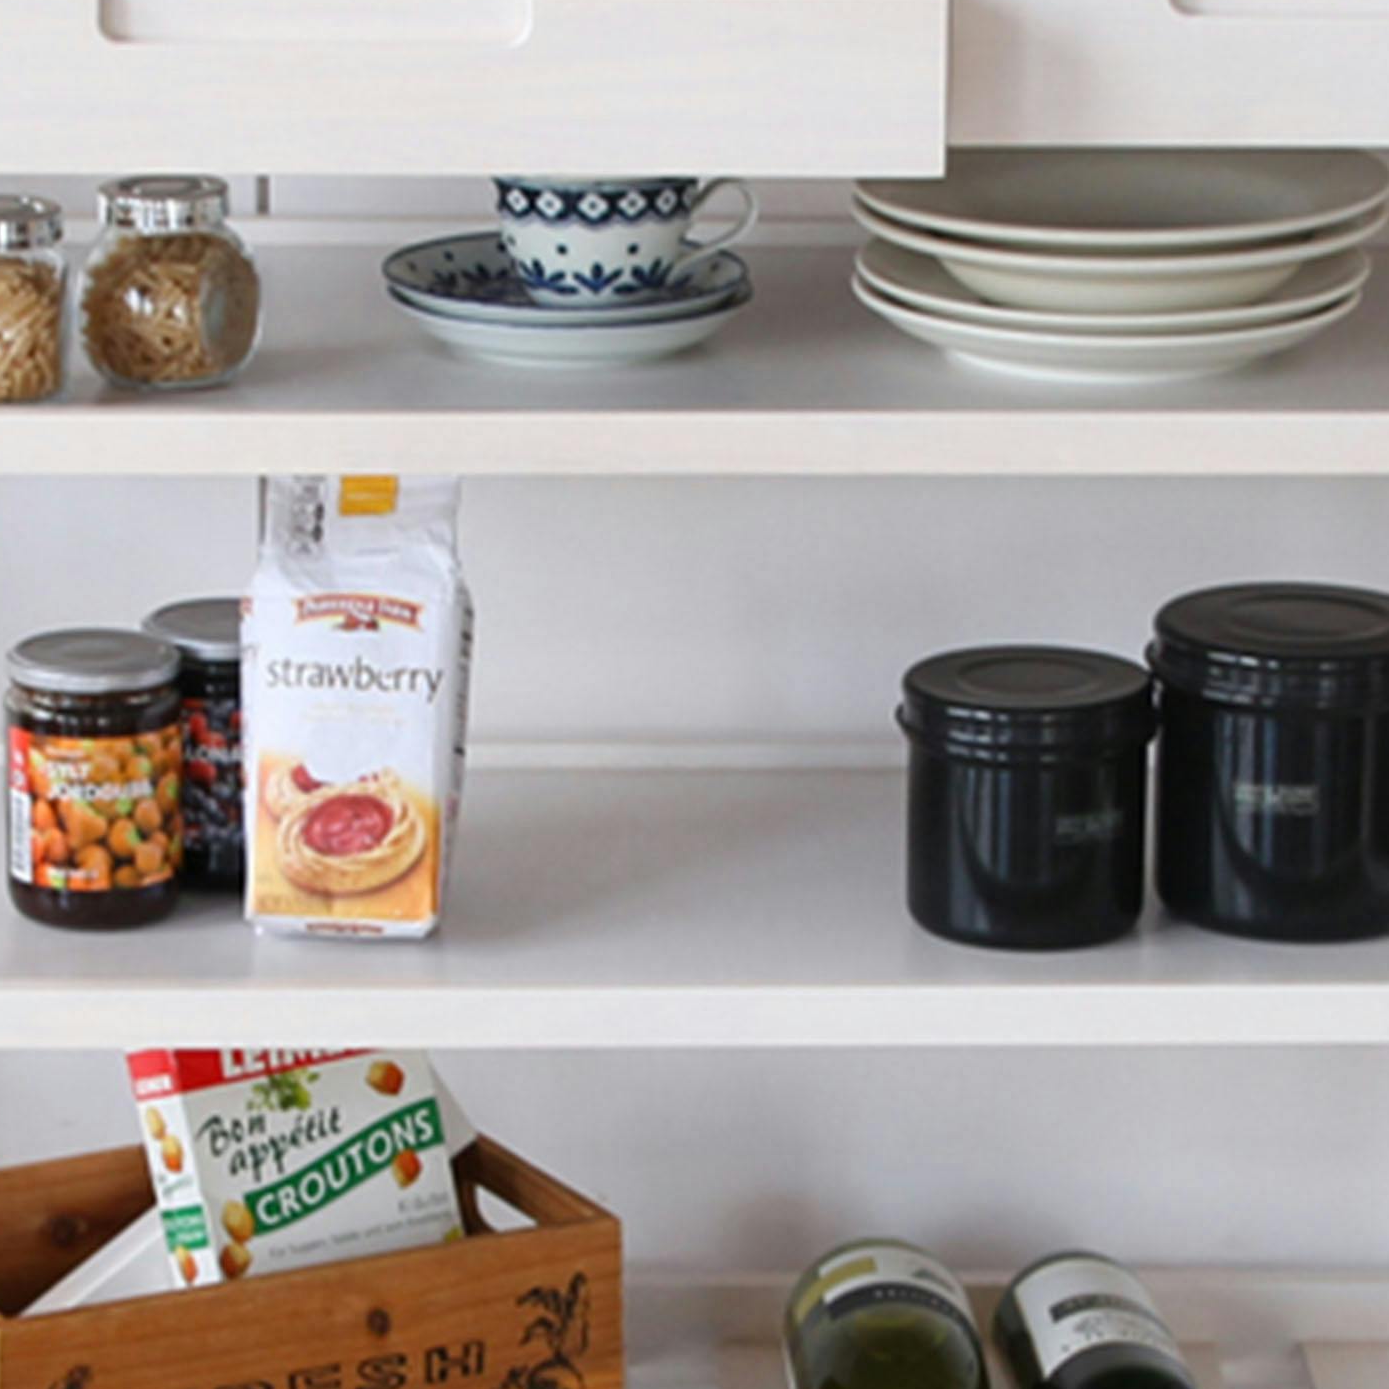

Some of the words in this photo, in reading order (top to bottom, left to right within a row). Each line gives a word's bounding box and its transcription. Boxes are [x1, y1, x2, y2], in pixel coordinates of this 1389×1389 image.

[266, 656, 445, 705] strawberry
[195, 1113, 268, 1158] Bon
[228, 1107, 343, 1183] appétit
[255, 1108, 435, 1226] CROUTONS
